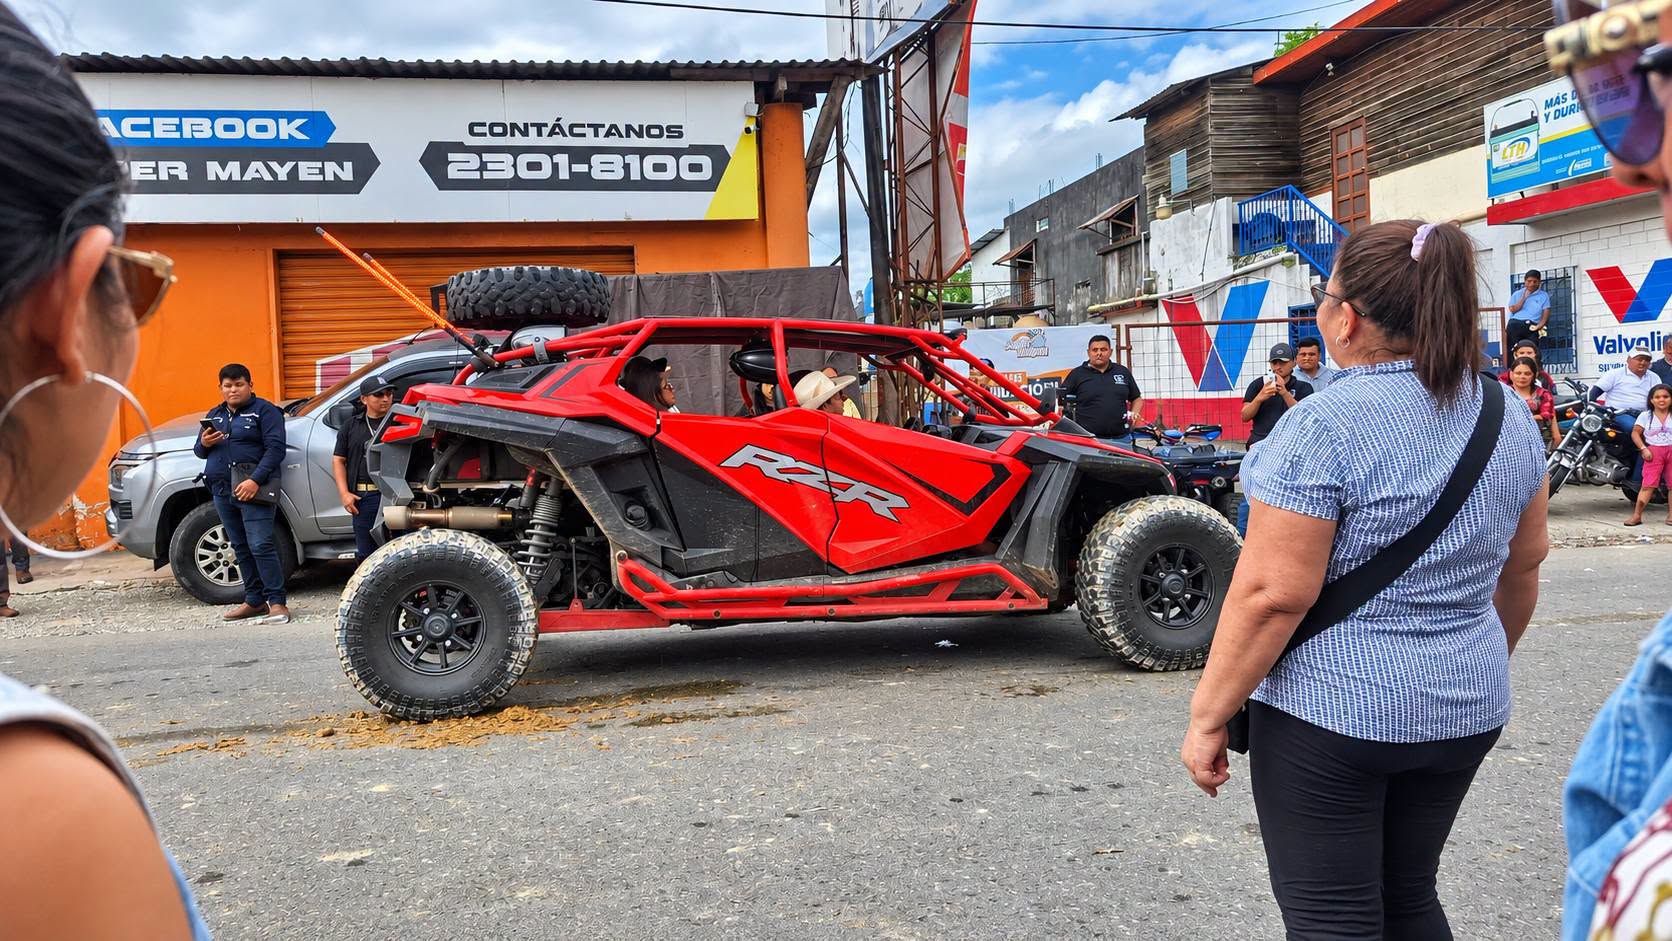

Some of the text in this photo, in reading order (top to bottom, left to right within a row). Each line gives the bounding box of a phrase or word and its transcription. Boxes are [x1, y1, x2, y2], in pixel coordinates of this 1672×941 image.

[1544, 92, 1568, 110] MÁS
[1544, 111, 1551, 123] Y
[467, 117, 684, 139] CONTÁCTANOS
[1502, 141, 1526, 160] LTH
[206, 160, 354, 181] MAYEN
[447, 152, 713, 181] 2301-8100
[1592, 330, 1669, 355] Valvoli
[718, 443, 911, 523] RZR
